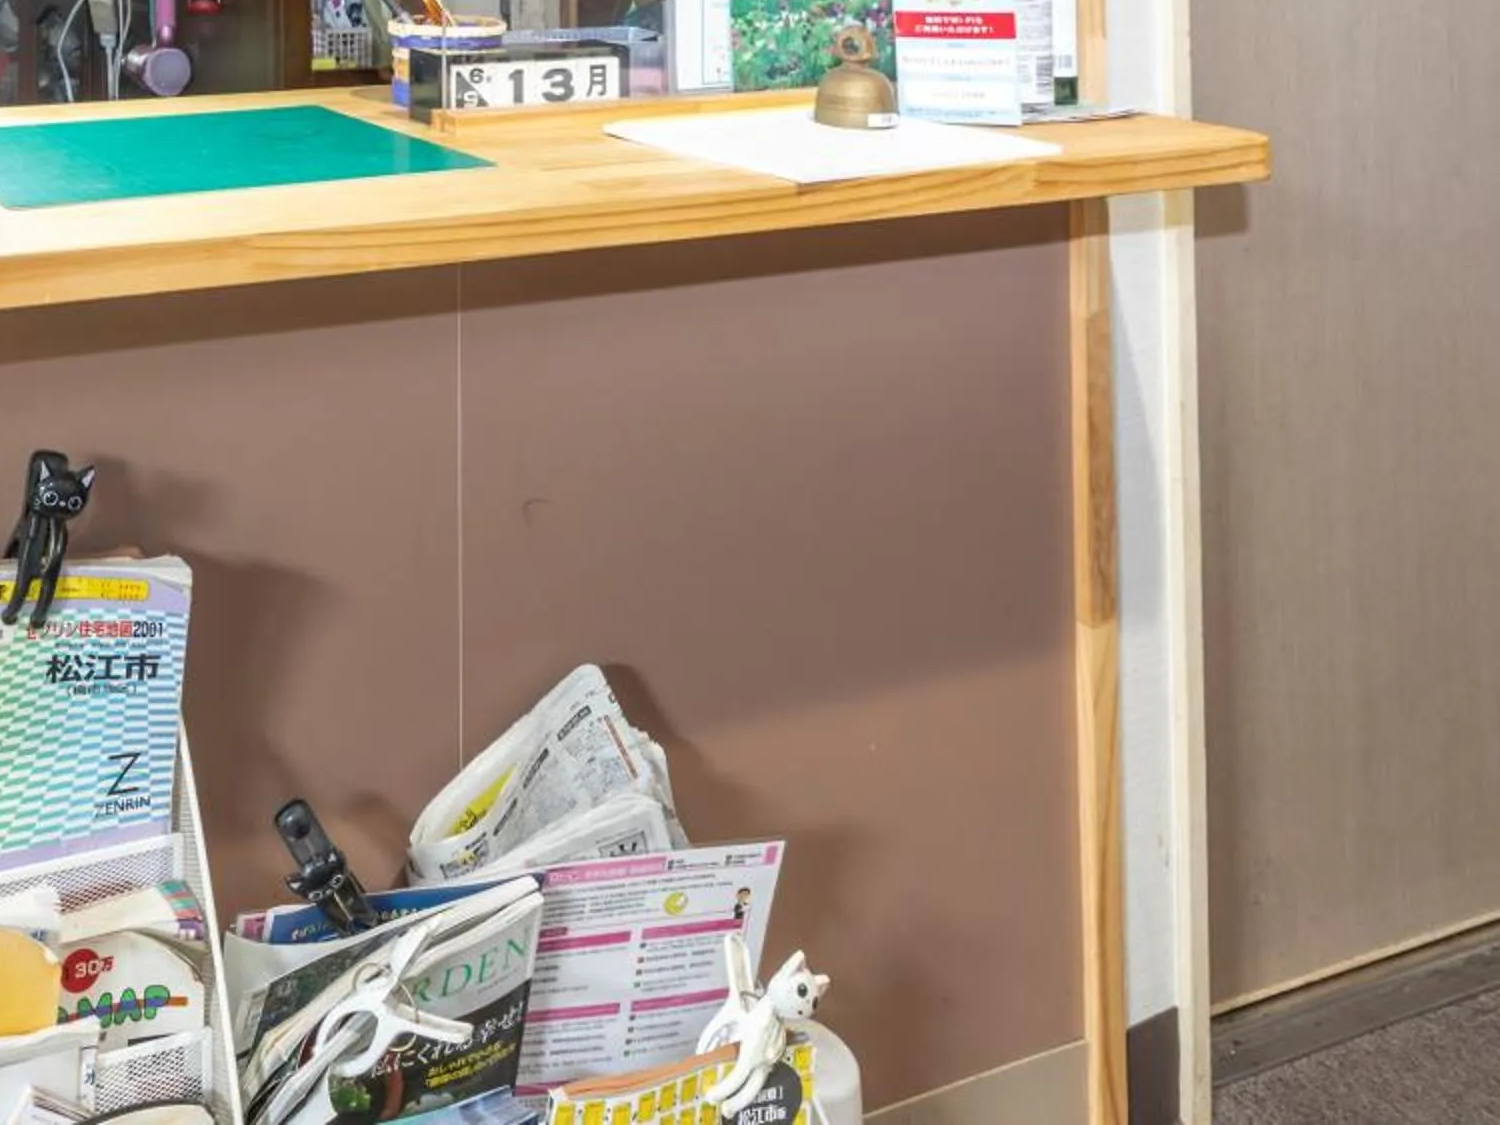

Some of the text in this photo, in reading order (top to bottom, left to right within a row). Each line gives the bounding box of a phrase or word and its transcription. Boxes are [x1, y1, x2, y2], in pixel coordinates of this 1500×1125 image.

[469, 68, 484, 83] 6
[509, 64, 606, 103] 13 月
[45, 653, 161, 683] 松江市
[94, 796, 151, 819] ZENRIN
[58, 984, 171, 1028] MAP
